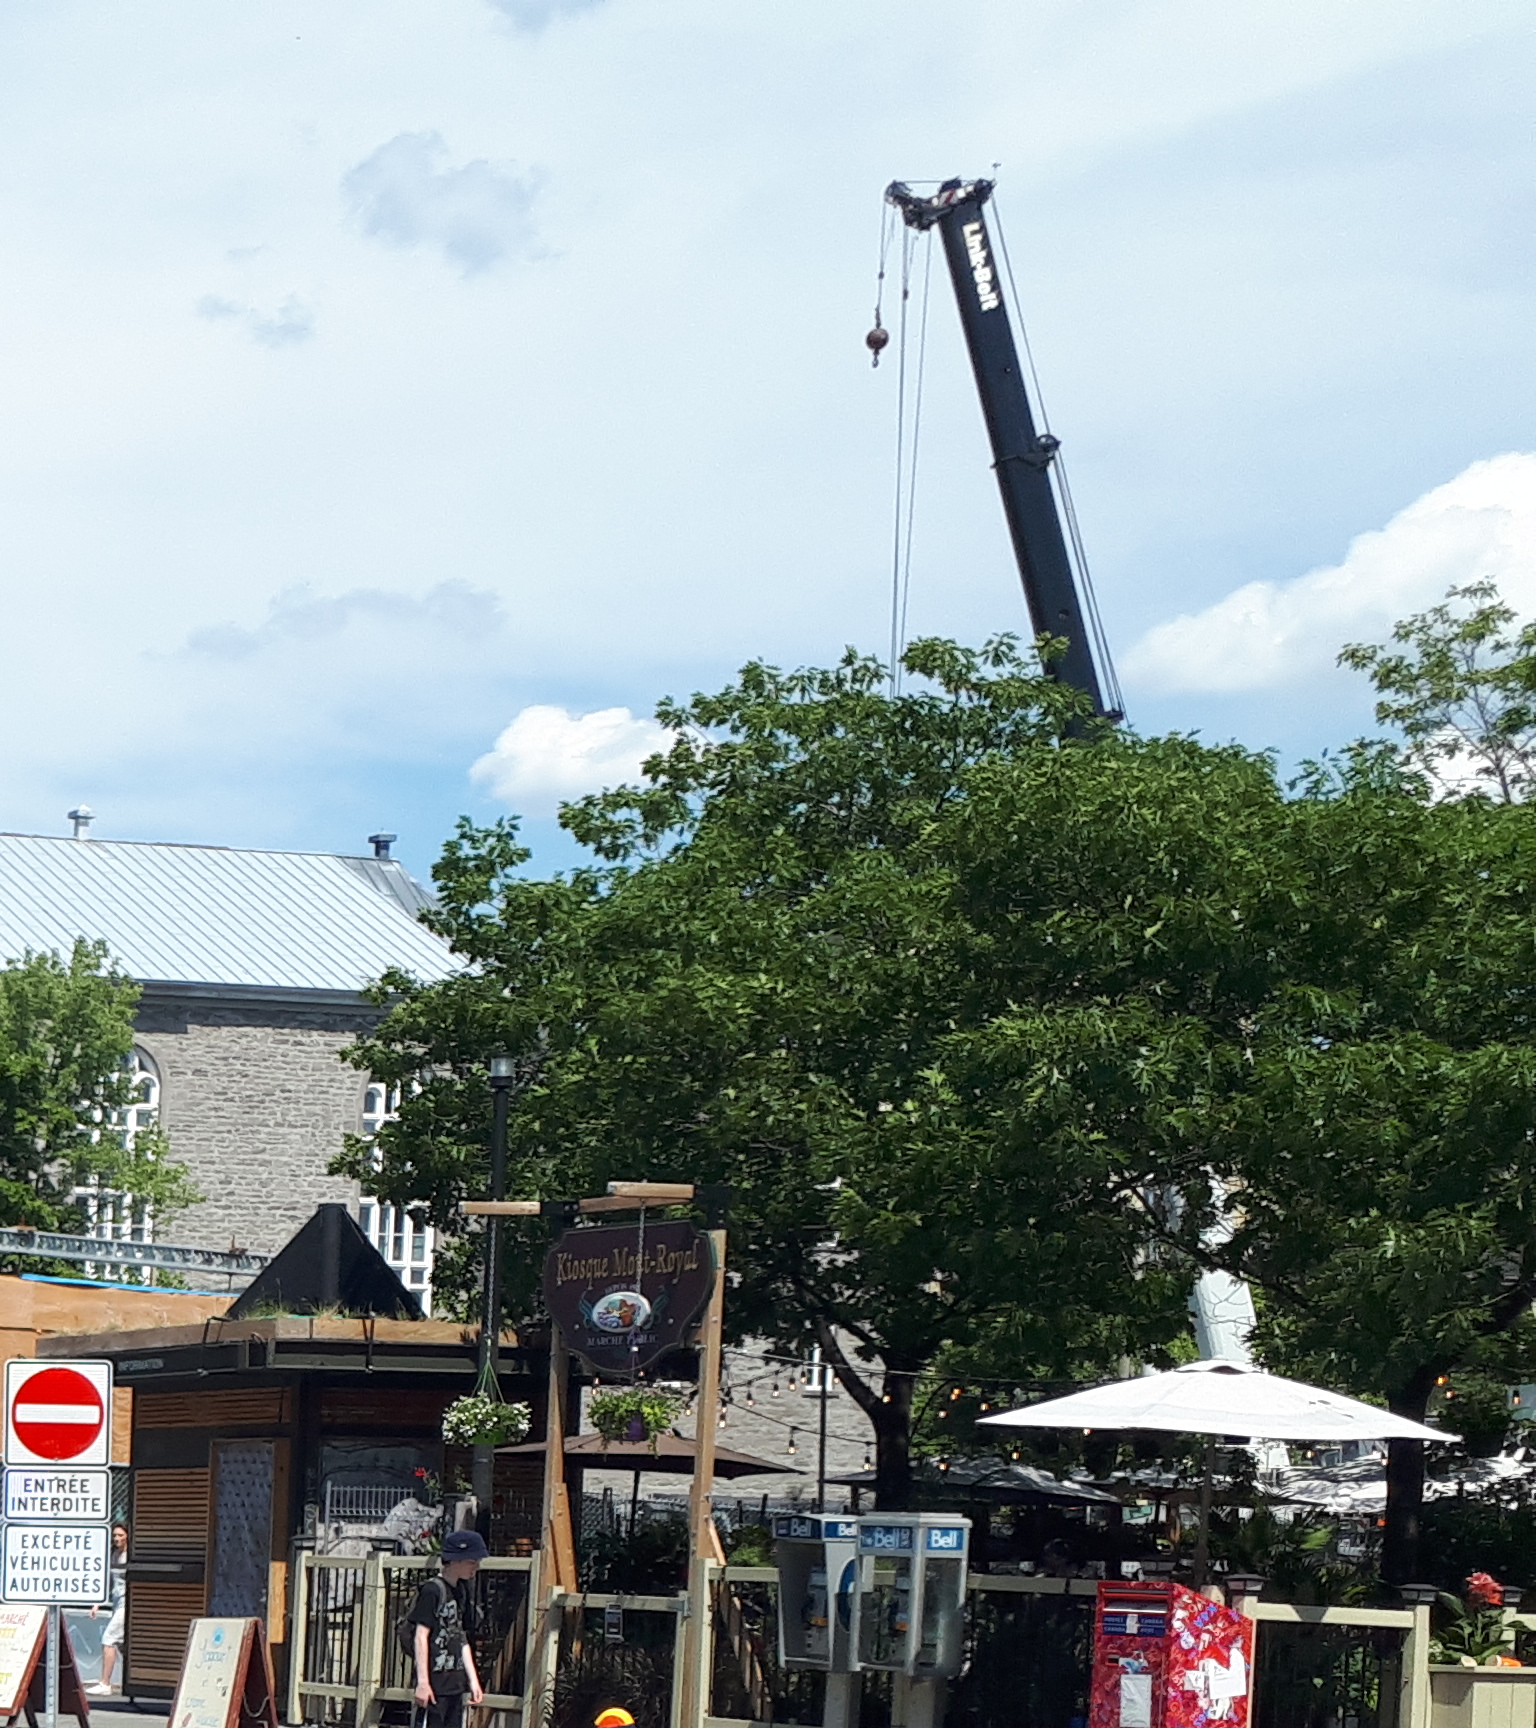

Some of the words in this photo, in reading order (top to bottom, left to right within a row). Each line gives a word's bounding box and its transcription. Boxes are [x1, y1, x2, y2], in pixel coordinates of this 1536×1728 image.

[556, 1252, 609, 1290] Kiosque
[23, 1474, 90, 1494] ENTRÉE
[11, 1496, 101, 1512] INTERDITE
[790, 1518, 812, 1537] Bell
[874, 1527, 901, 1548] Bell
[931, 1529, 958, 1548] Bell
[9, 1551, 102, 1572] VÉHICULES
[9, 1573, 101, 1593] AUTORISÉS
